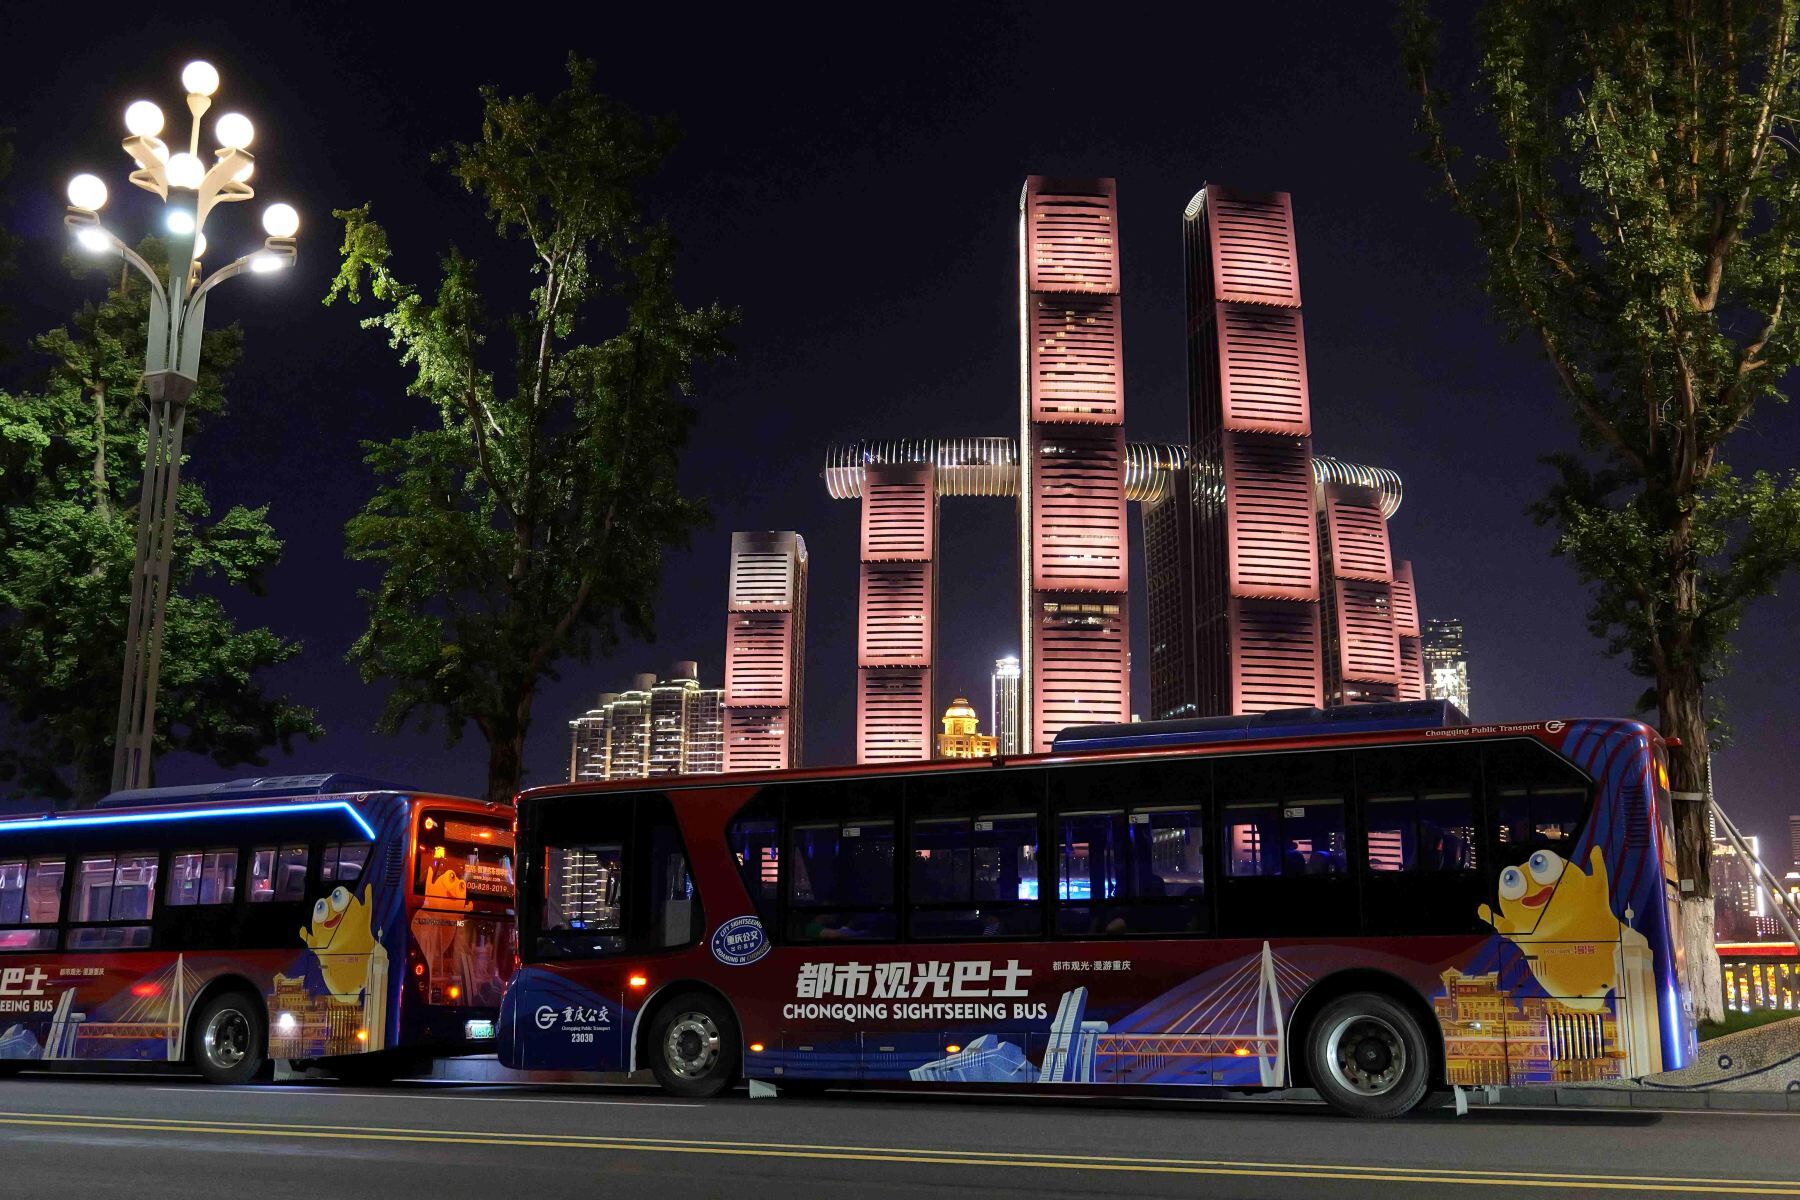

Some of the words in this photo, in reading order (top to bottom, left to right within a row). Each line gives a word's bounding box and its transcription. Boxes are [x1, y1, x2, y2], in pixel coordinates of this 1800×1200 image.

[1425, 727, 1470, 736] Chongqing
[1499, 724, 1540, 732] Transport
[720, 926, 730, 938] CITY
[726, 930, 759, 946] 重庆公交
[796, 959, 1033, 998] 都市观光巴士
[33, 1000, 54, 1012] BUS
[783, 1003, 888, 1022] CHONGQING
[893, 1003, 1007, 1019] SIGHTSEEING
[1013, 1003, 1048, 1019] BUS
[561, 1005, 611, 1023] 重庆公交
[571, 1033, 594, 1043] 23030
